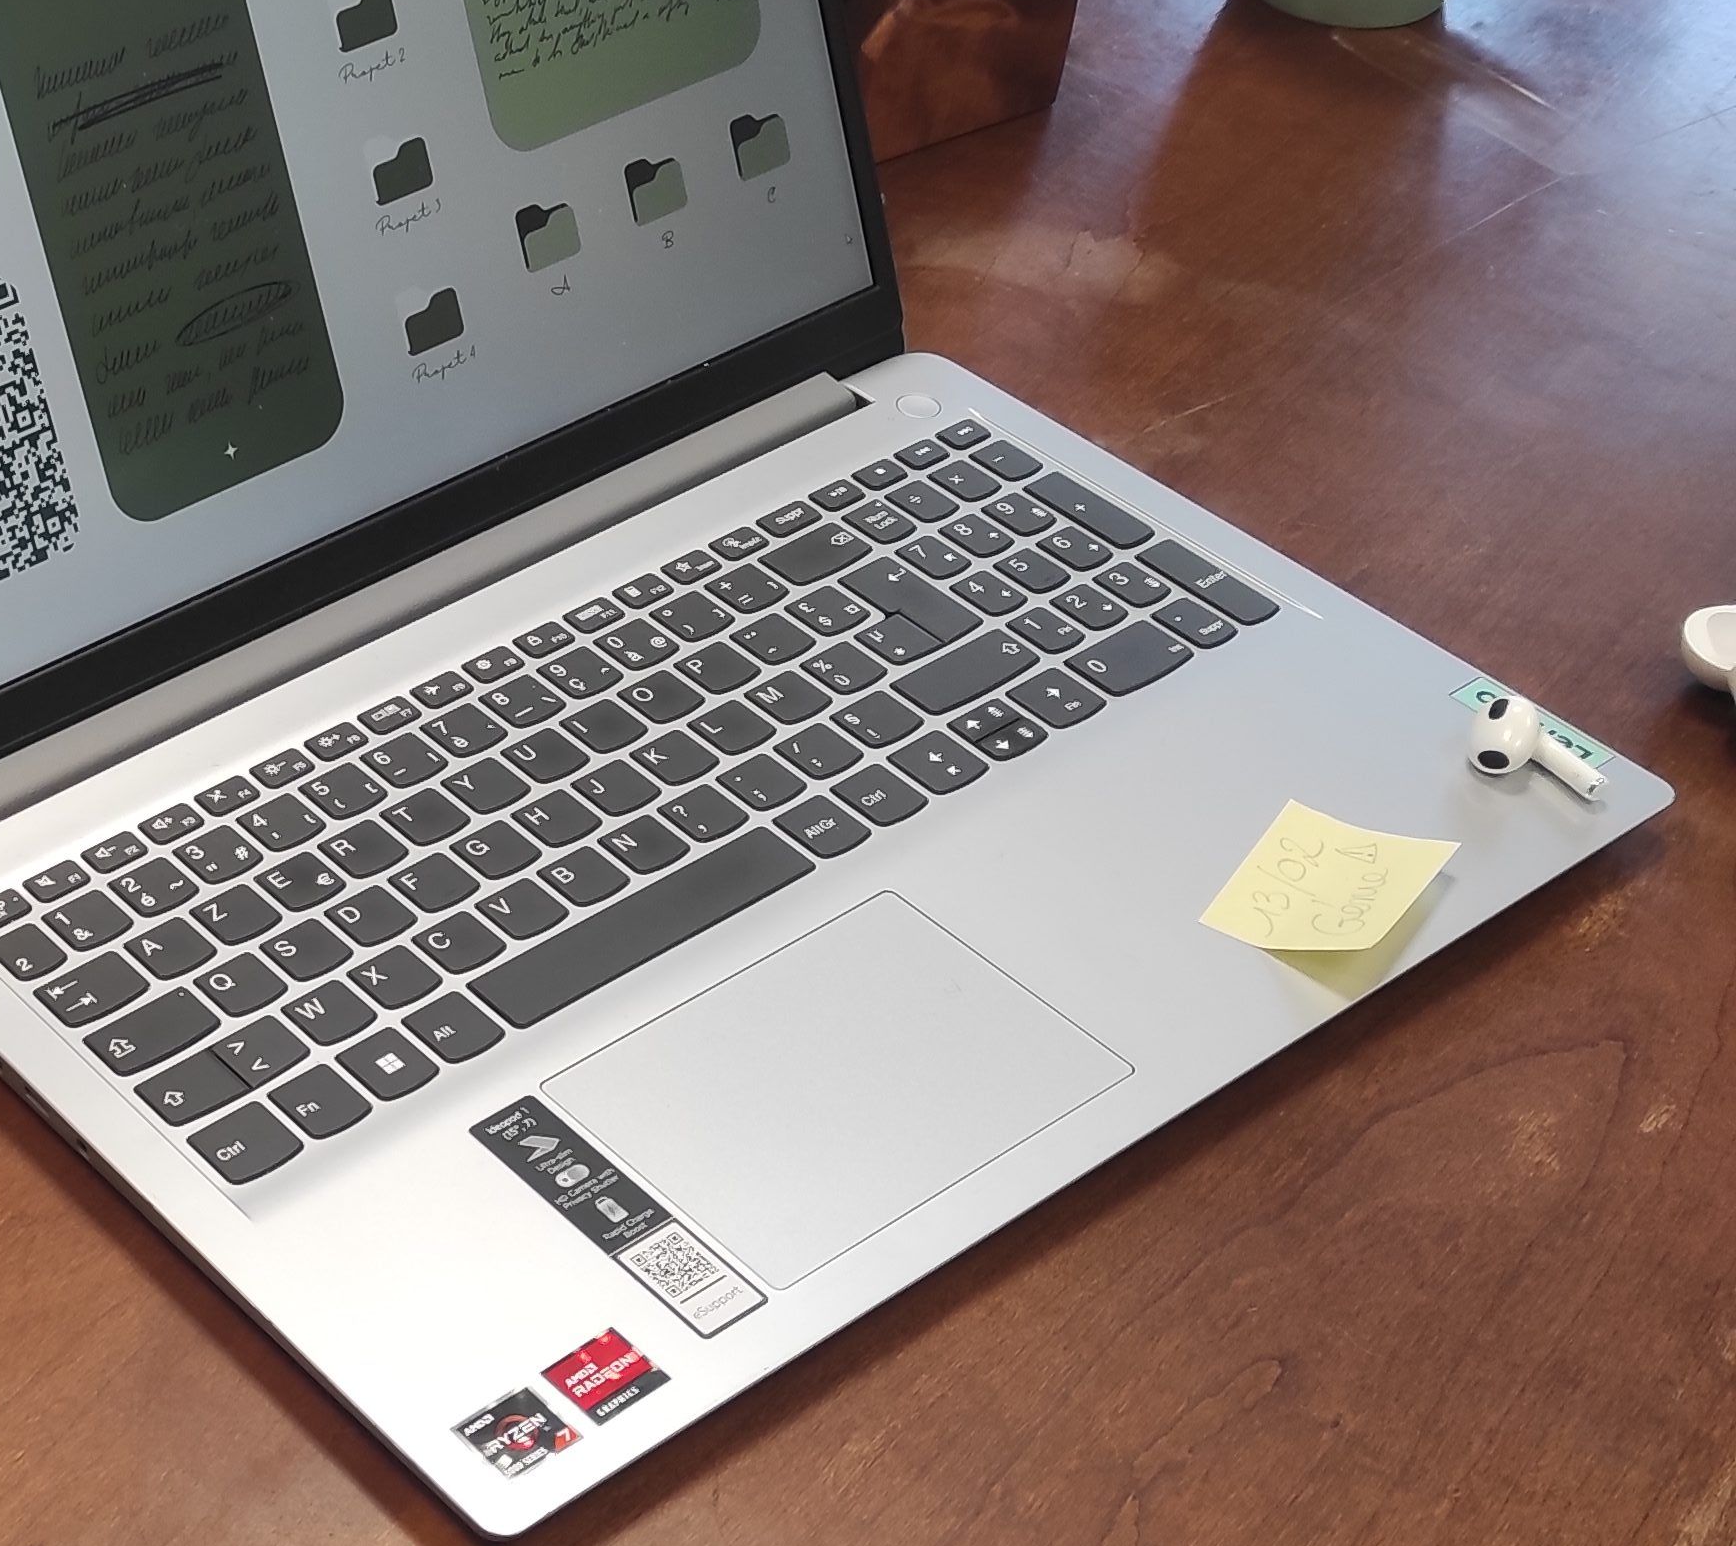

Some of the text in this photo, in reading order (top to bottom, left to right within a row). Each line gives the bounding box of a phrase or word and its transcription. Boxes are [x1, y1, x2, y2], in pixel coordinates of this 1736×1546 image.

[661, 230, 674, 249] B
[996, 503, 1014, 514] 9
[953, 524, 972, 535] 8
[1053, 537, 1071, 548] 6
[908, 545, 926, 559] 7
[1008, 558, 1028, 571] 5
[1109, 572, 1129, 585] 3
[1196, 571, 1229, 589] Enter
[969, 581, 984, 593] 4
[1066, 595, 1087, 608] 2
[1024, 618, 1041, 629] 1
[650, 637, 667, 648] @
[549, 665, 567, 676] 9
[686, 659, 702, 674] P
[1087, 660, 1106, 672] 0
[492, 693, 509, 705] 8
[632, 688, 654, 701] O
[756, 686, 784, 703] M
[432, 721, 447, 734] 7
[571, 721, 588, 733] I
[700, 722, 723, 733] L
[373, 752, 391, 764] 6
[513, 745, 536, 760] U
[642, 748, 667, 765] K
[311, 781, 330, 795] 5
[452, 775, 474, 790] Y
[590, 779, 605, 794] J
[861, 790, 886, 806] Ctrl
[253, 814, 267, 826] 4
[392, 807, 412, 821] T
[524, 807, 549, 825] H
[330, 839, 356, 856] R
[465, 840, 490, 855] G
[611, 834, 637, 851] N
[185, 845, 204, 859] 3
[266, 871, 292, 889] E
[399, 873, 417, 890] F
[551, 867, 574, 884] B
[120, 877, 141, 893] 2
[1251, 838, 1324, 937] 13/02
[203, 903, 228, 922] Z
[488, 898, 510, 914] V
[55, 912, 70, 925] 1
[337, 907, 360, 923] D
[142, 939, 163, 956] A
[428, 932, 450, 949] C
[274, 941, 296, 956] S
[209, 974, 236, 990] Q
[361, 966, 388, 985] X
[295, 998, 325, 1019] W
[433, 1026, 456, 1041] Alt
[296, 1102, 320, 1117] Fn
[216, 1141, 245, 1161] Ctrl
[694, 1286, 743, 1319] eSupport
[483, 1413, 548, 1457] RYZEN
[557, 1428, 569, 1441] 7
